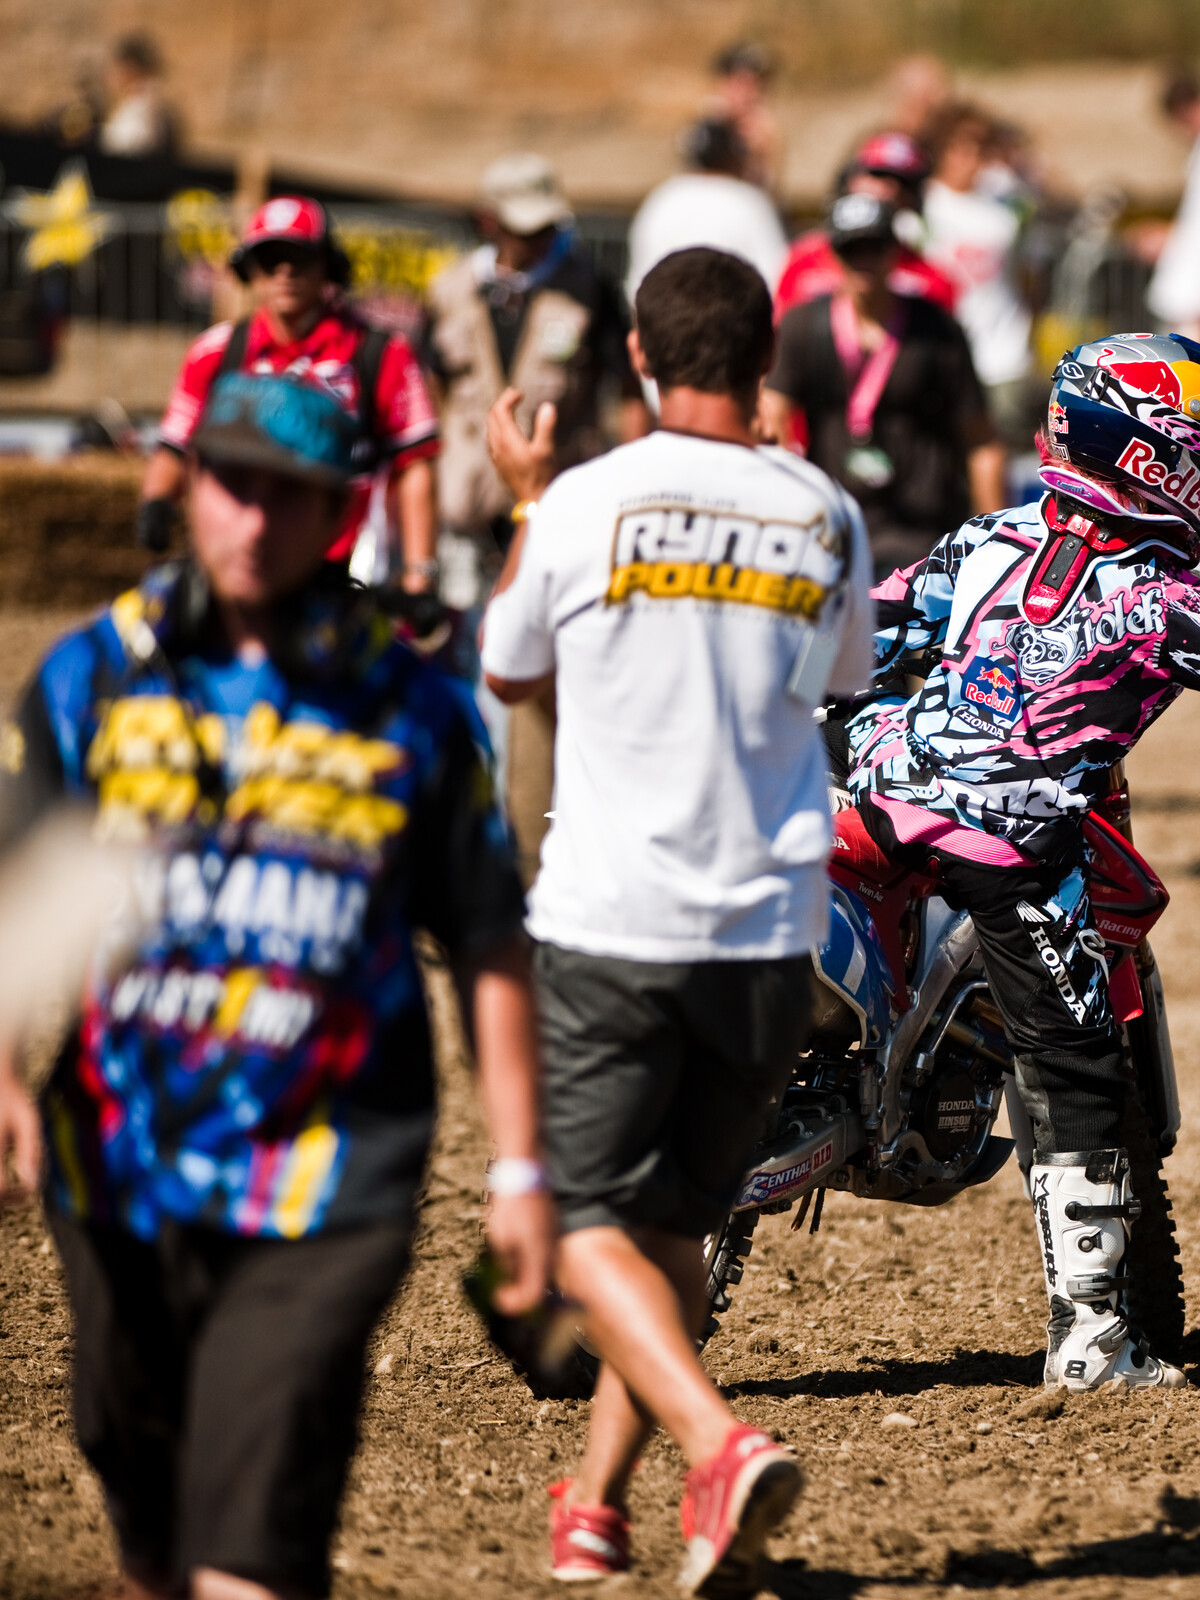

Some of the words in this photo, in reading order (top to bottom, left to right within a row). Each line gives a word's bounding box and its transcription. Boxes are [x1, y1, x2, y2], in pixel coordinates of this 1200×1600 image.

[606, 560, 828, 624] POWER
[959, 708, 1007, 740] HONDA
[858, 881, 875, 899] Twin
[874, 890, 885, 903] Air
[1099, 919, 1142, 940] Racing
[1029, 925, 1087, 1025] HONDA
[937, 1100, 976, 1112] HONDA
[937, 1115, 971, 1127] HINSON
